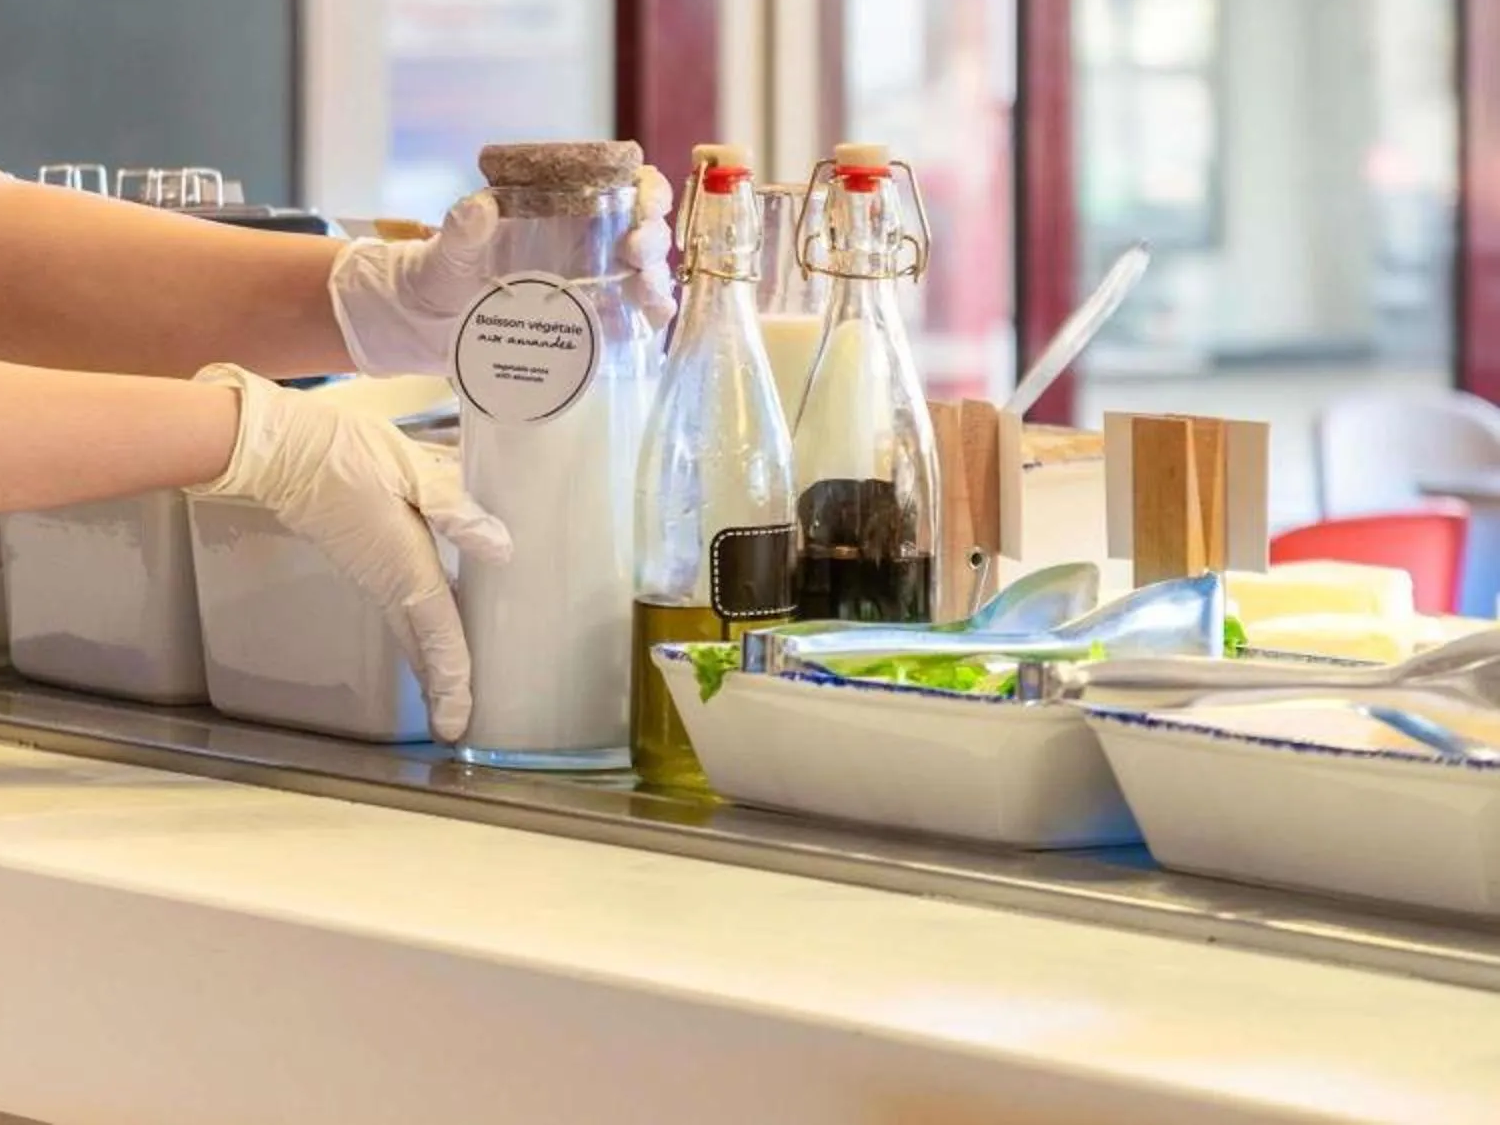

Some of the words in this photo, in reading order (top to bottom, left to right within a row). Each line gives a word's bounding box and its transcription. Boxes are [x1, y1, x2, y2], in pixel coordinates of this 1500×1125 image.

[476, 314, 525, 328] Boisson
[528, 321, 583, 336] végétale
[478, 333, 502, 344] aux
[508, 335, 577, 350] amandes
